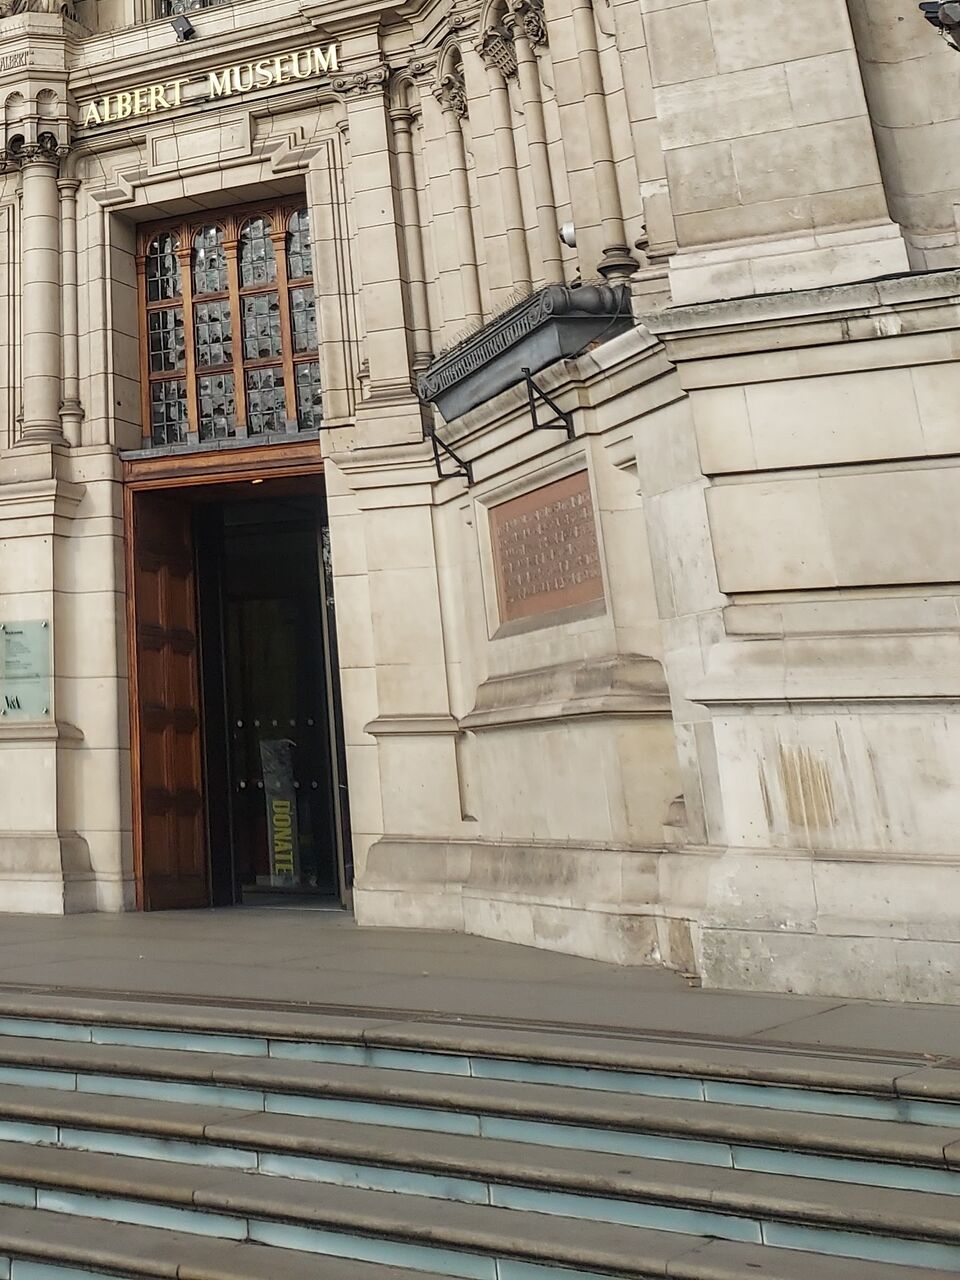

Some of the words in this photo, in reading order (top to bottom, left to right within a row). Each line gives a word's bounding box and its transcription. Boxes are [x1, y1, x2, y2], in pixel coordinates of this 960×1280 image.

[83, 78, 190, 127] ALBERT
[208, 44, 340, 99] MUSEUM
[272, 799, 294, 876] DONATE
